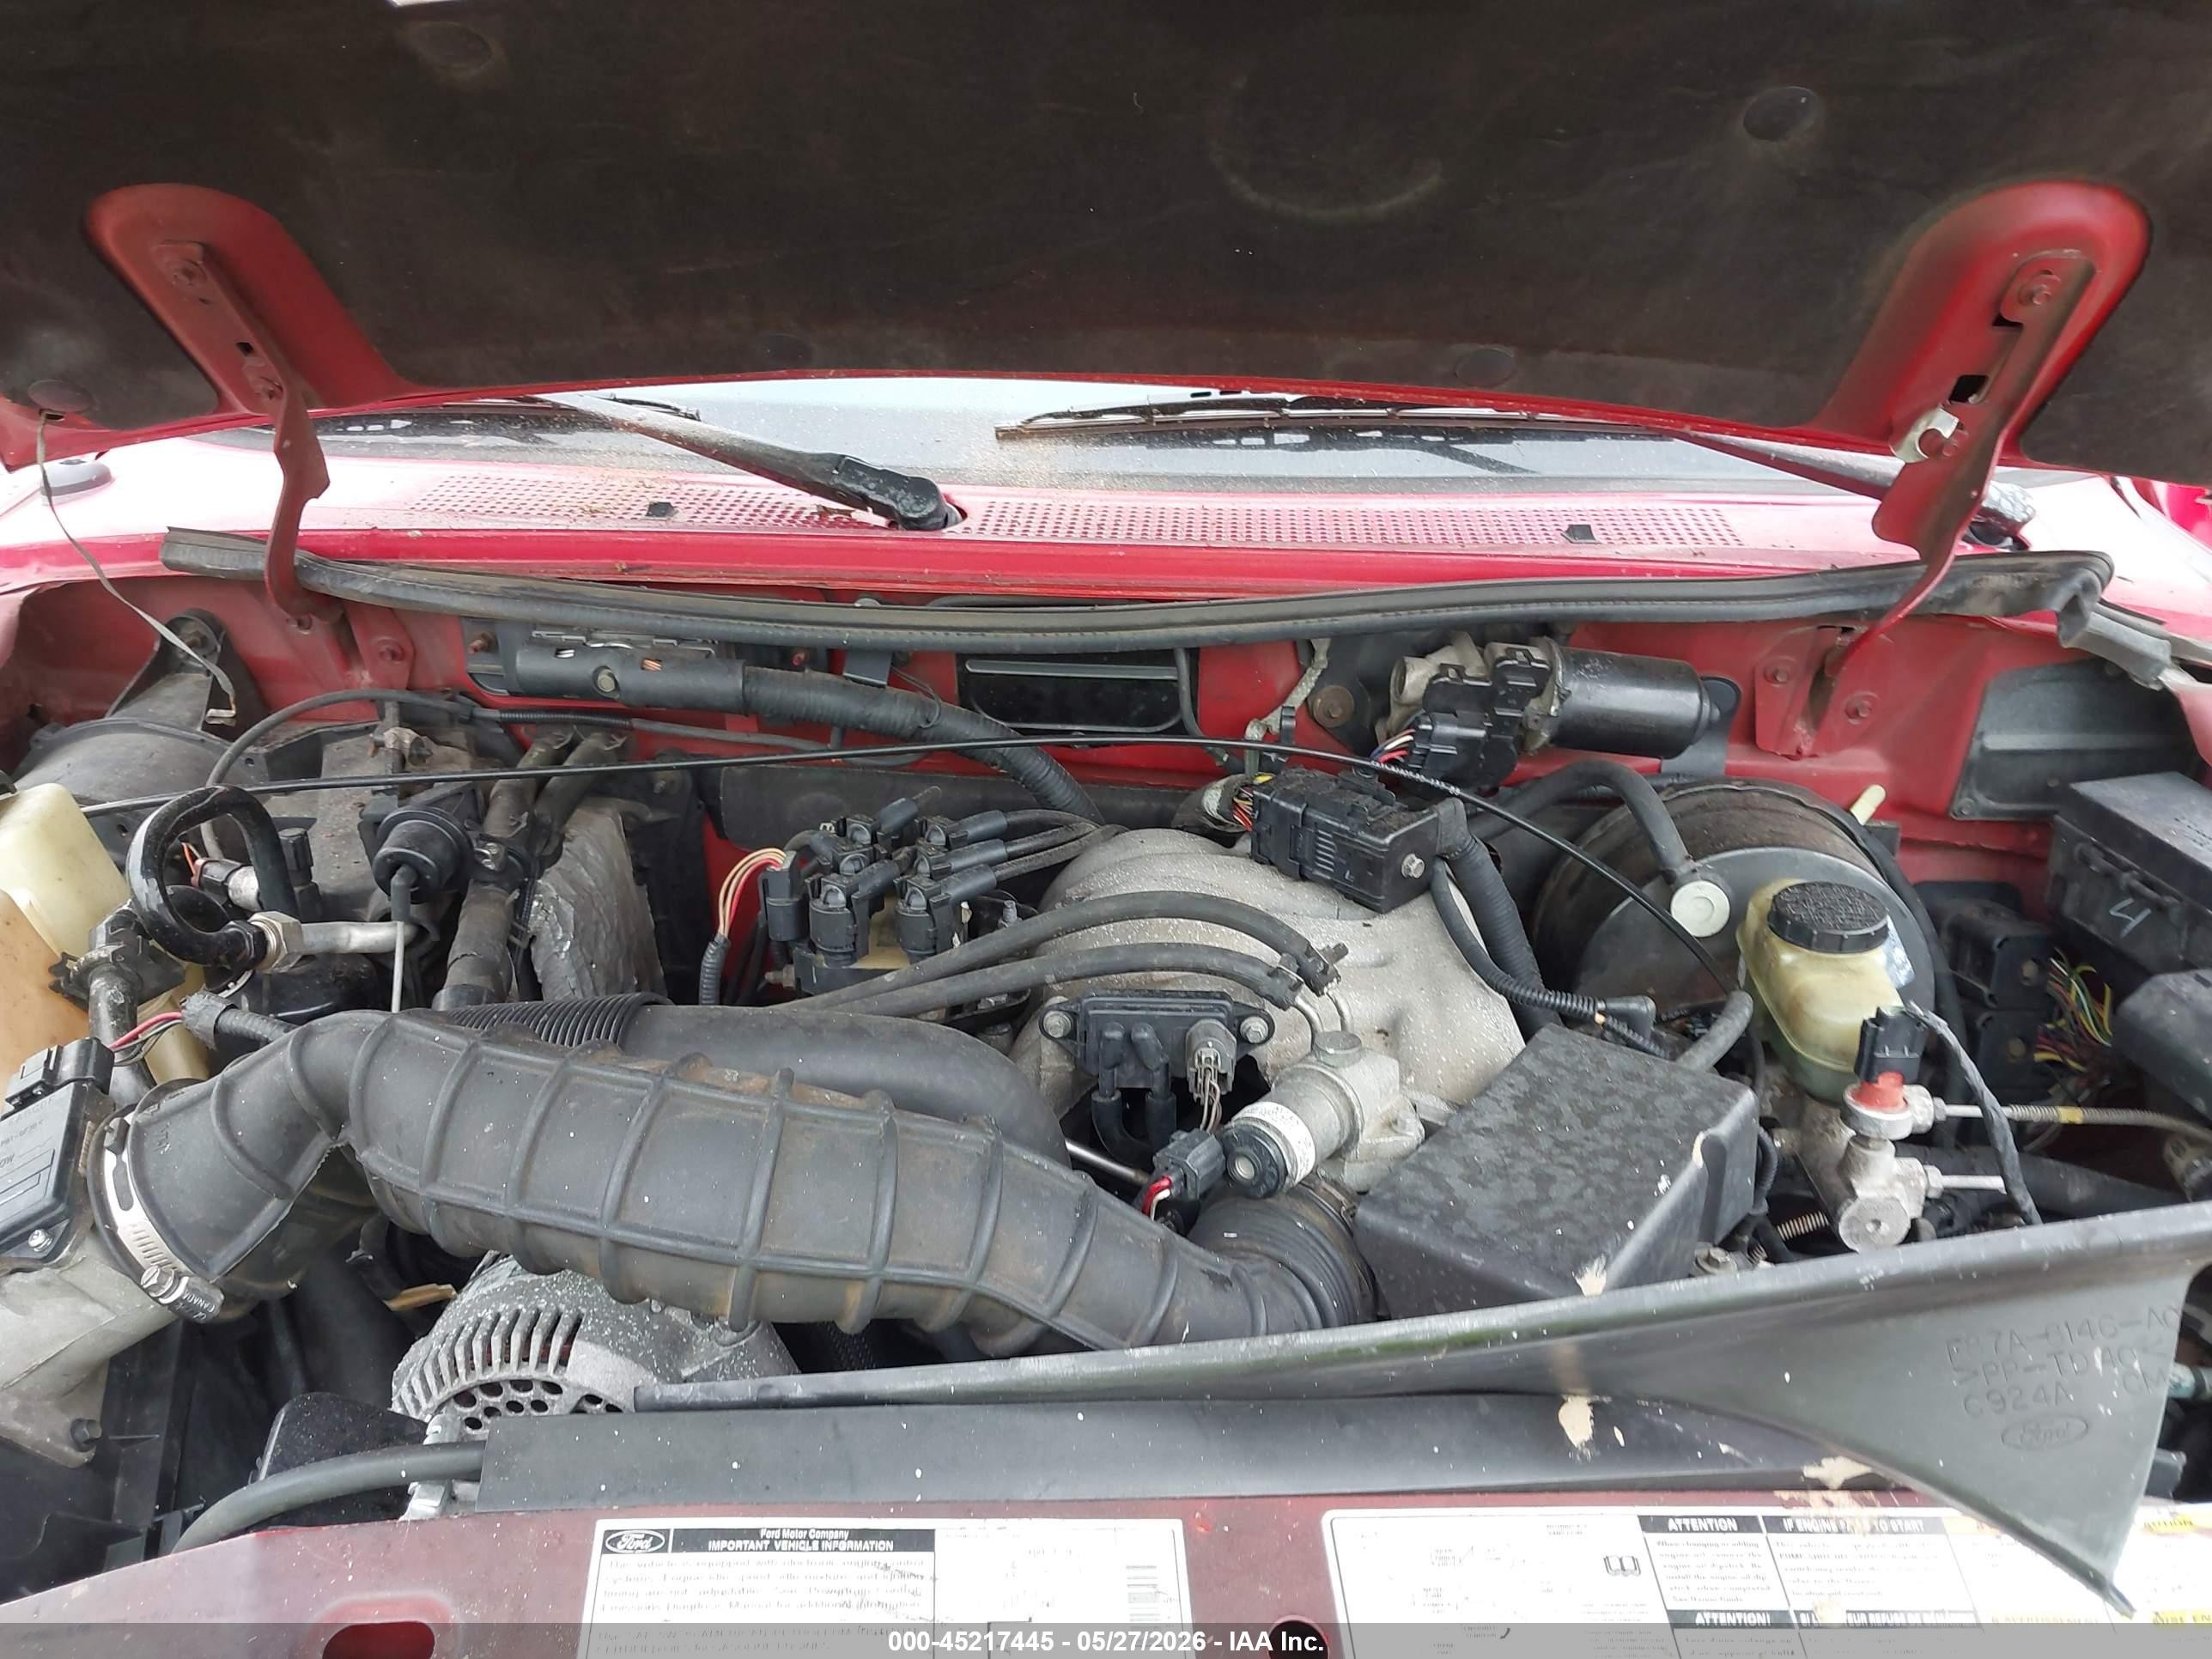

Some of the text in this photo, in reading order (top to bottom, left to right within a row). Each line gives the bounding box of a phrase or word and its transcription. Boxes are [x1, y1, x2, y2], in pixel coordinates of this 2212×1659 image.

[182, 1291, 216, 1313] CANADA
[1668, 1517, 1739, 1532] ATTENTION
[1783, 1518, 1794, 1532] IF
[1795, 1518, 1838, 1532] ENGINE
[1875, 1519, 1888, 1532] TO
[1889, 1519, 1924, 1533] START
[760, 1528, 850, 1540] Ford Motor Company
[708, 1540, 894, 1552] IMPORTANT VEHICLE INFORMATION
